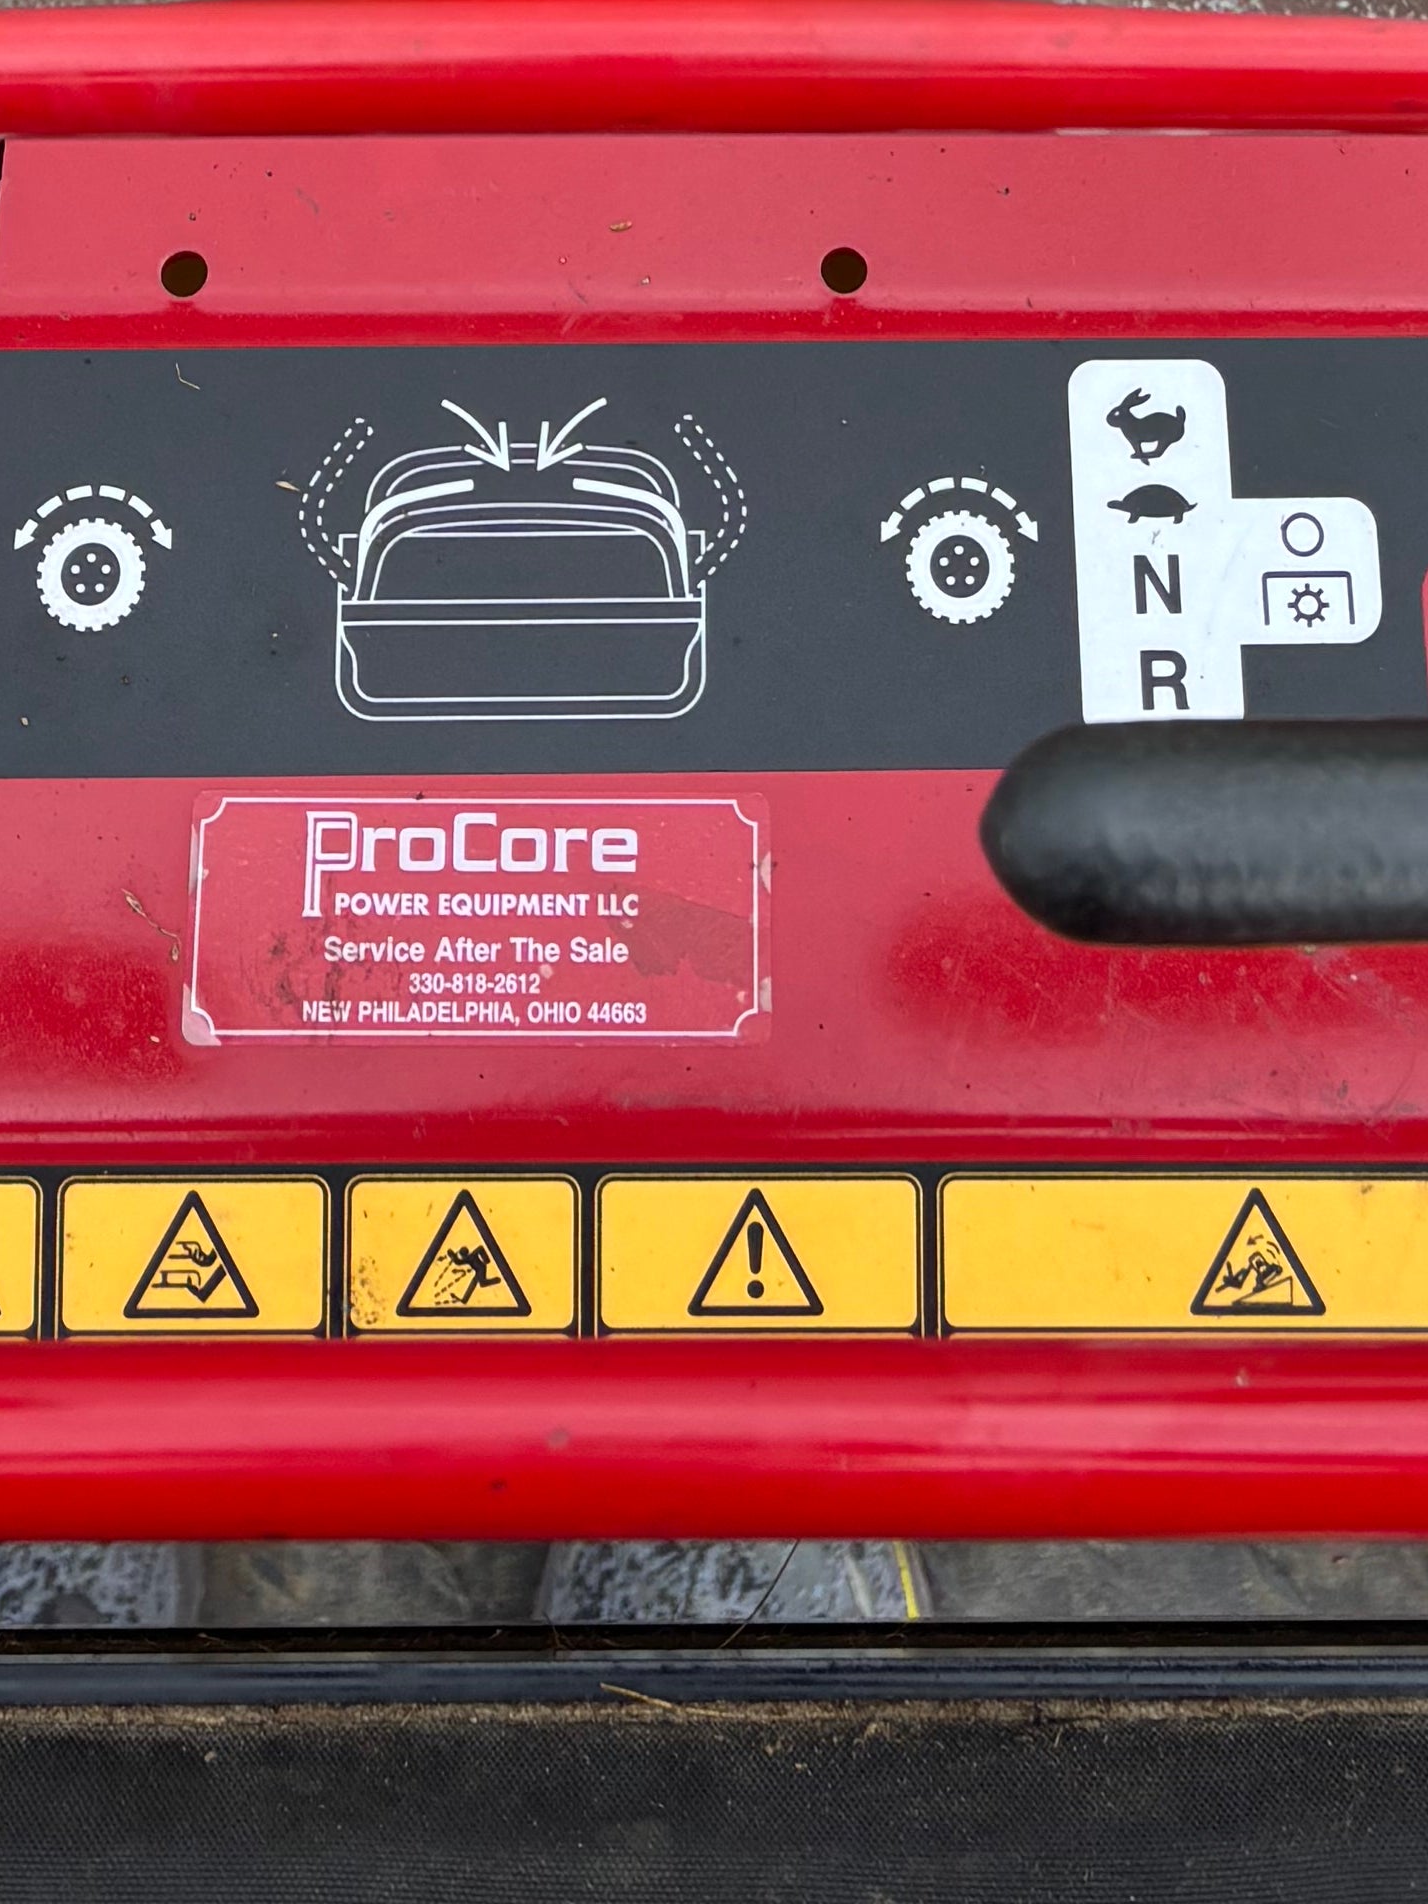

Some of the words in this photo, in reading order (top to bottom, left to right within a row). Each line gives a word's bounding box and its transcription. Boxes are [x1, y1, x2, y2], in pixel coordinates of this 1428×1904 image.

[1133, 554, 1182, 614] N
[1140, 650, 1190, 711] R
[302, 810, 639, 918] ProCore
[334, 893, 429, 917] POWER
[438, 893, 589, 917] EQUIPMENT
[597, 893, 639, 917] LLC
[324, 936, 424, 963] Service
[434, 936, 501, 963] After
[509, 936, 561, 963] The
[569, 936, 629, 963] Sale
[409, 973, 540, 995] 330-818-2612
[303, 1001, 352, 1023] NEW
[358, 1001, 521, 1026] PHILADELPHIA,
[528, 1001, 581, 1023] OHIO
[587, 1001, 647, 1023] 44663
